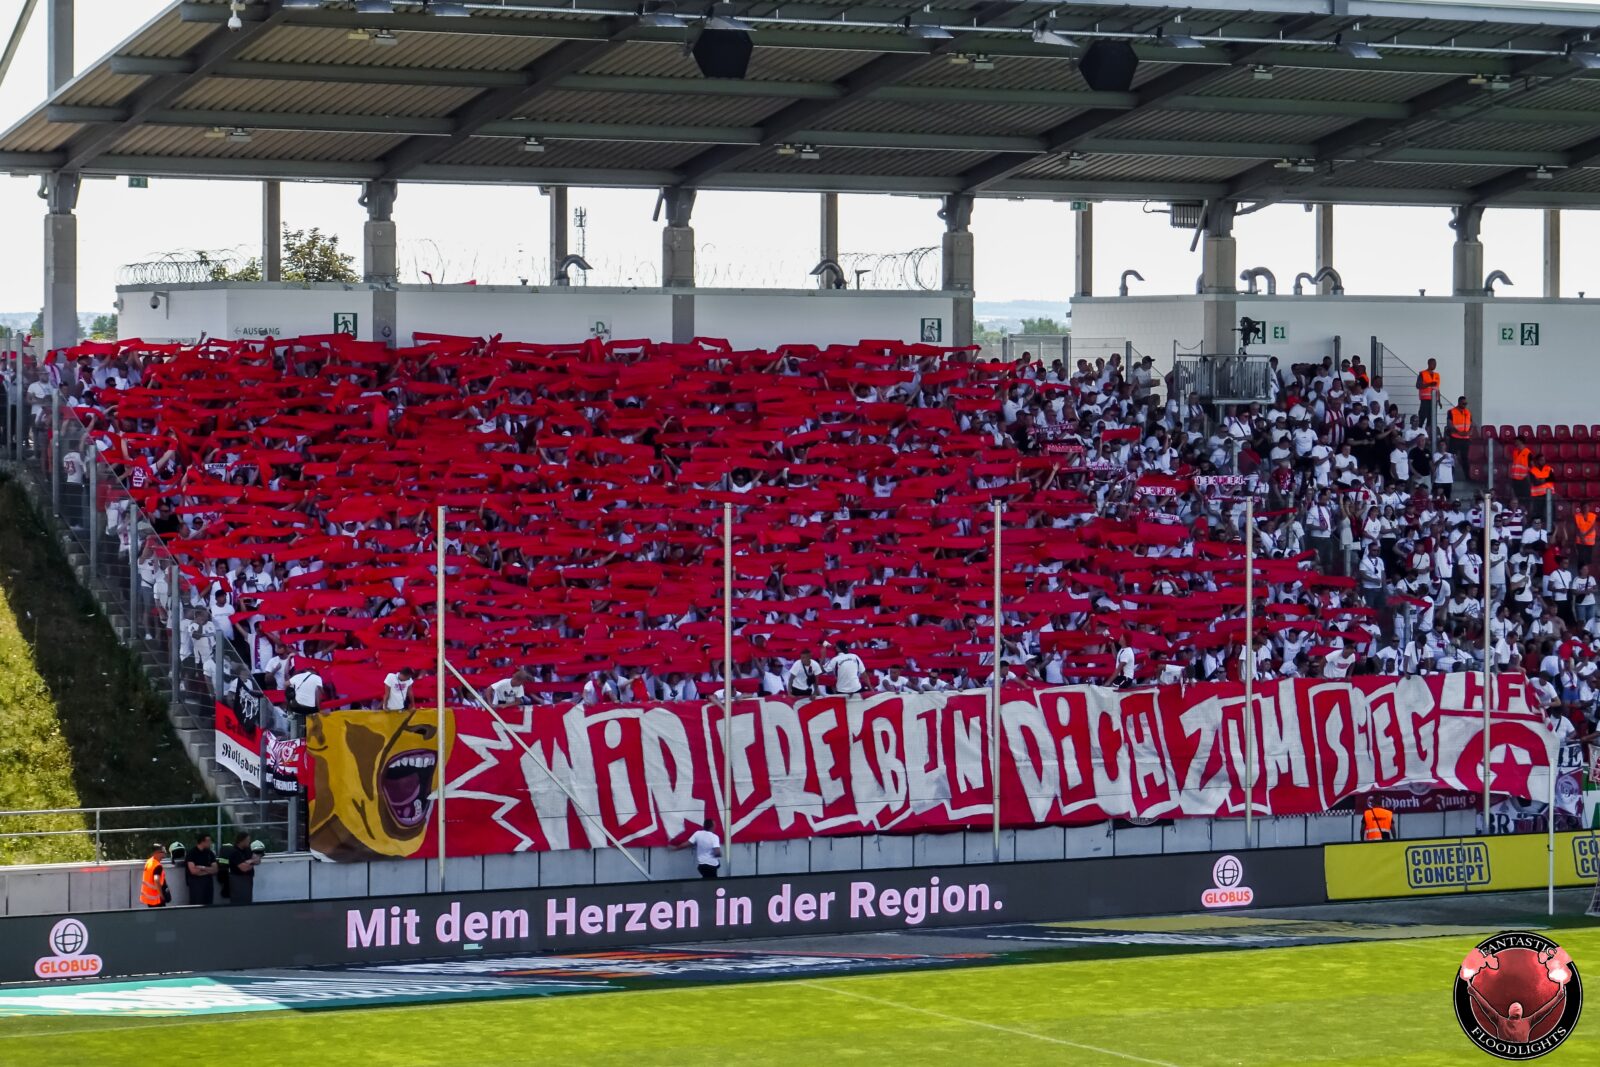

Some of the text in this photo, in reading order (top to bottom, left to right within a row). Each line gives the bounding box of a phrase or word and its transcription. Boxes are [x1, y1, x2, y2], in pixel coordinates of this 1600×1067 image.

[1273, 326, 1286, 339] E1
[1502, 327, 1513, 340] E2
[1411, 846, 1483, 867] COMEDIA
[1413, 864, 1484, 885] CONCEPT
[1205, 890, 1250, 904] GLOBUS
[347, 876, 1003, 948] Mit dem Herzen in der Region.
[39, 959, 99, 974] GLOBUS
